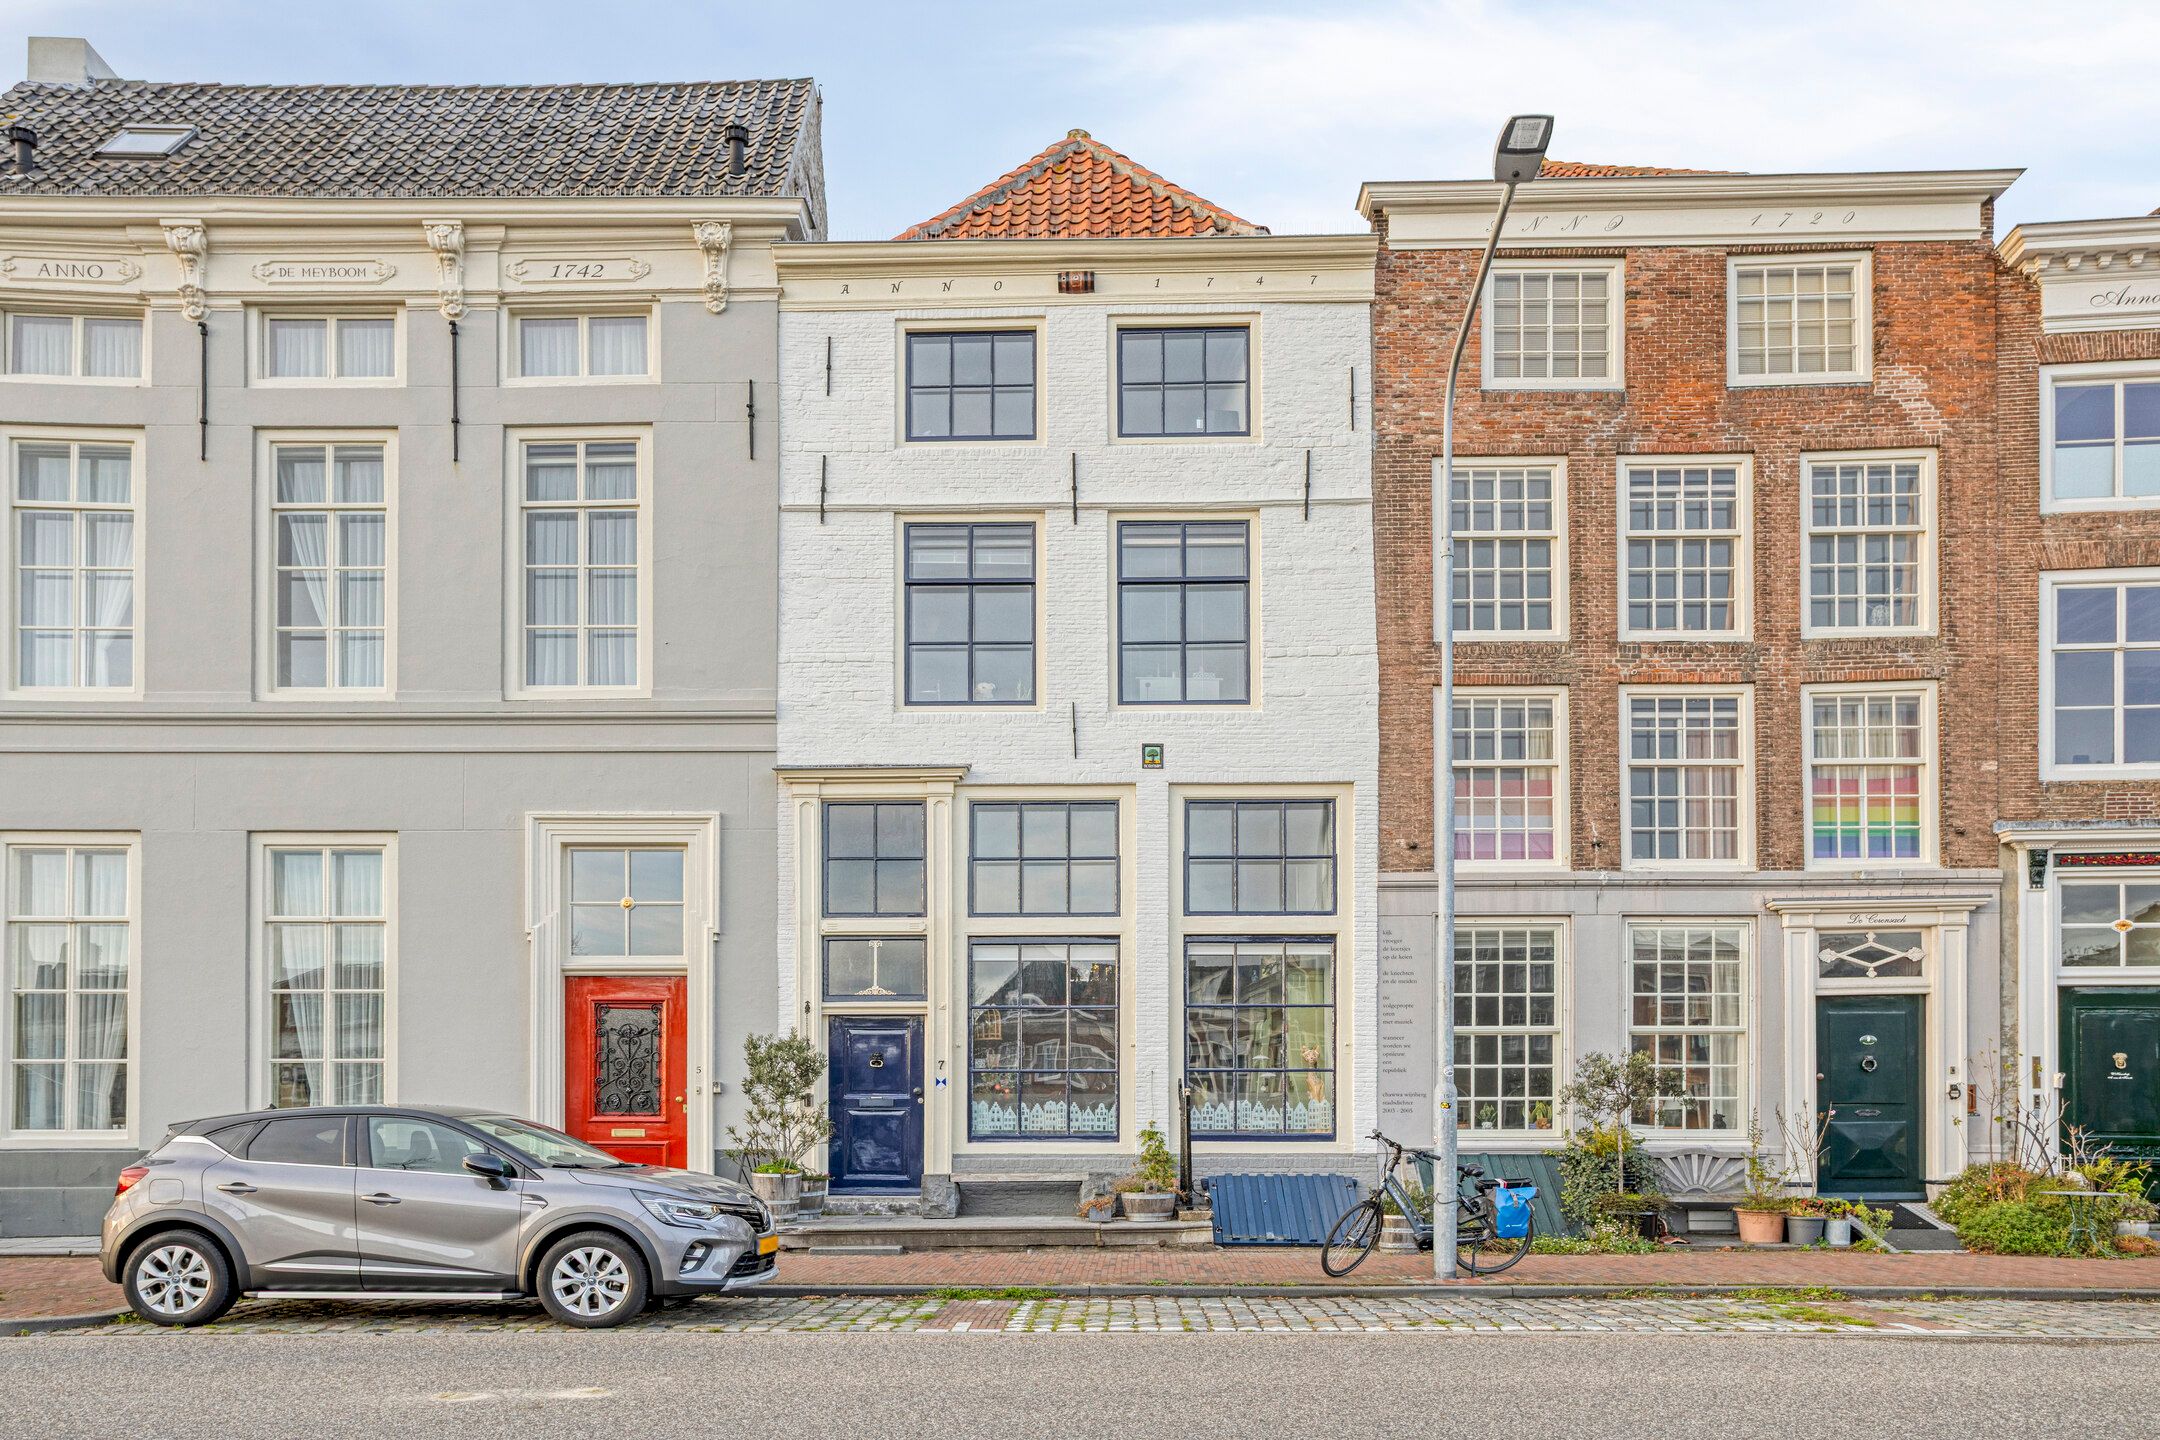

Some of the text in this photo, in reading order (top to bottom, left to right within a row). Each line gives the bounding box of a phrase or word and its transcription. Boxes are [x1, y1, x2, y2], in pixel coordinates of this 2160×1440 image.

[1751, 210, 1856, 227] 1720
[38, 263, 103, 278] ANNO
[279, 267, 367, 278] DE MEYBOOM
[550, 264, 604, 278] 1742
[840, 274, 1318, 295] ANNO 1747
[696, 1066, 702, 1074] 5
[938, 1060, 945, 1070] 7
